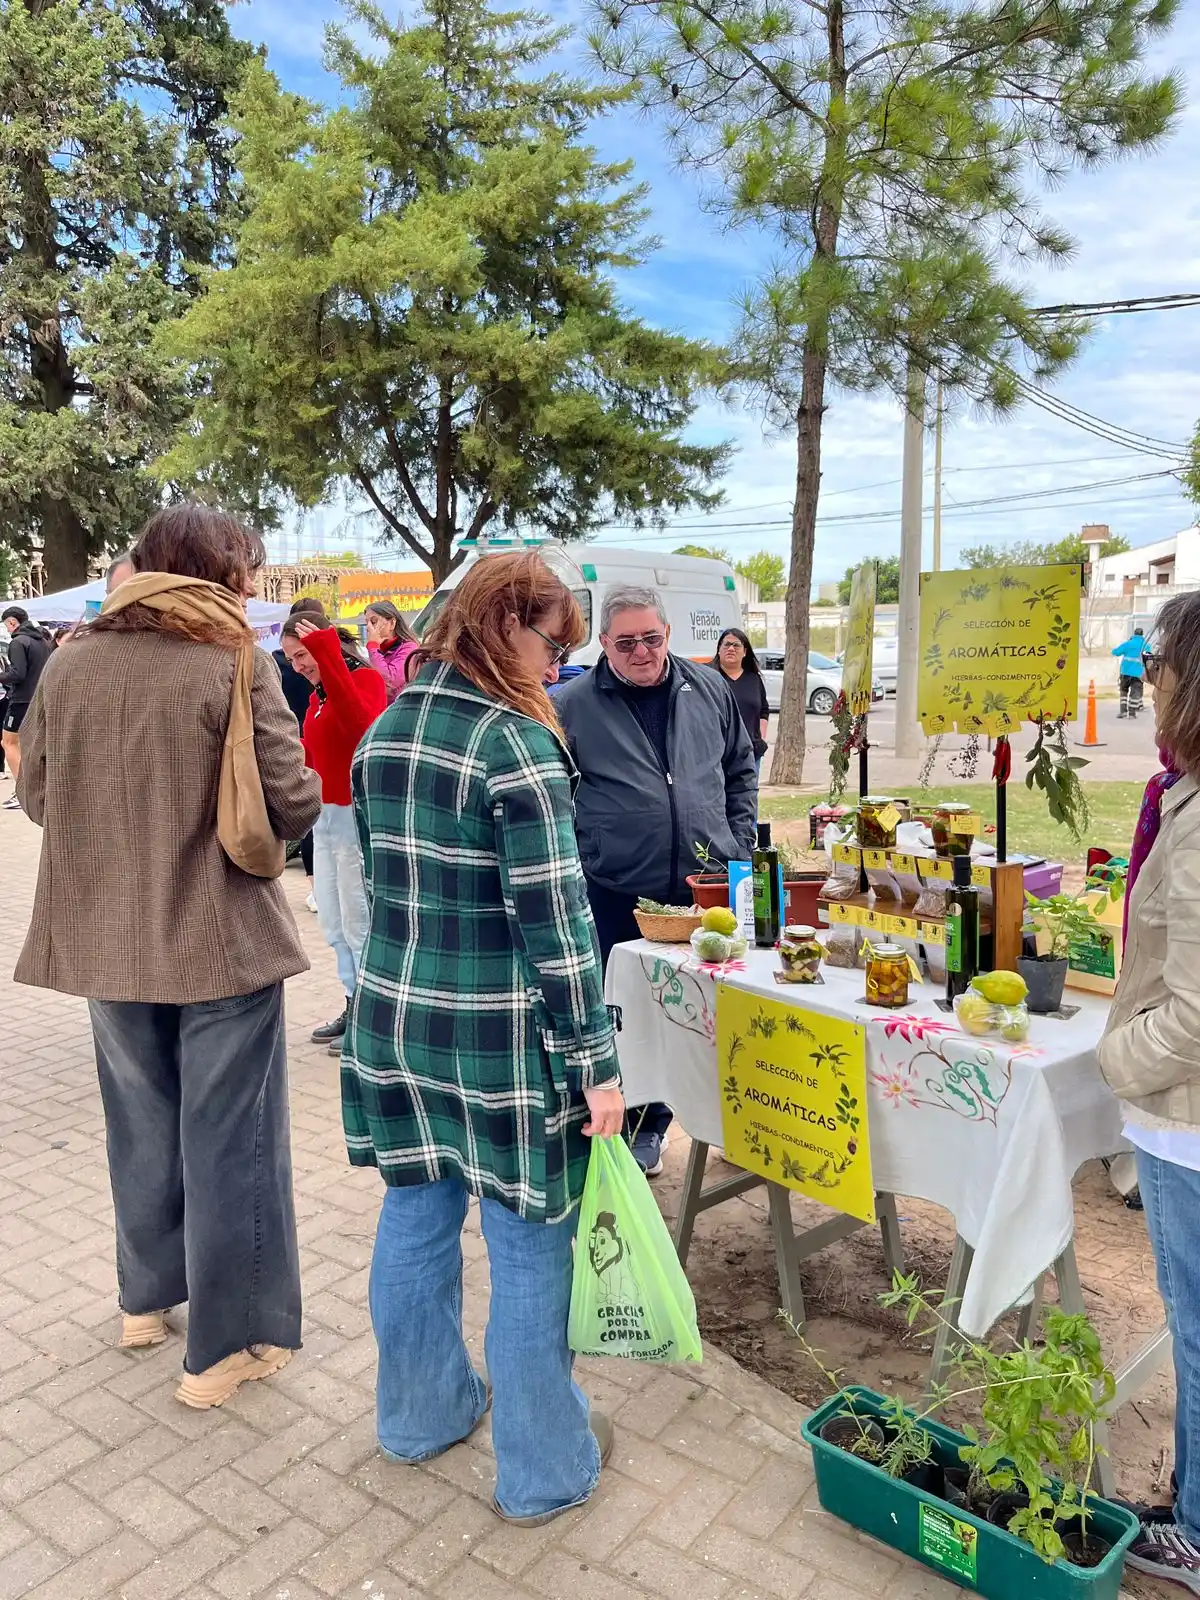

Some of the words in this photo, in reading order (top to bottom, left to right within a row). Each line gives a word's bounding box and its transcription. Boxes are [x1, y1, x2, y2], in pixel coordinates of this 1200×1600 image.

[690, 611, 720, 626] Venado
[963, 618, 1015, 629] SELECCIÓN
[1019, 619, 1031, 628] DE
[691, 626, 719, 641] Tuerto
[948, 642, 1047, 658] AROMÁTICAS
[951, 673, 1042, 681] HIERBAS-CONDIMENTOS
[755, 1060, 803, 1083] SELECCIÓN
[807, 1077, 818, 1089] DE
[744, 1087, 836, 1131] AROMÁTICAS
[750, 1120, 834, 1159] HIERBAS-CONDIMENTOS
[607, 1317, 629, 1328] POR
[600, 1329, 651, 1342] COMPRA
[616, 1339, 675, 1359] AUTORIZADA
